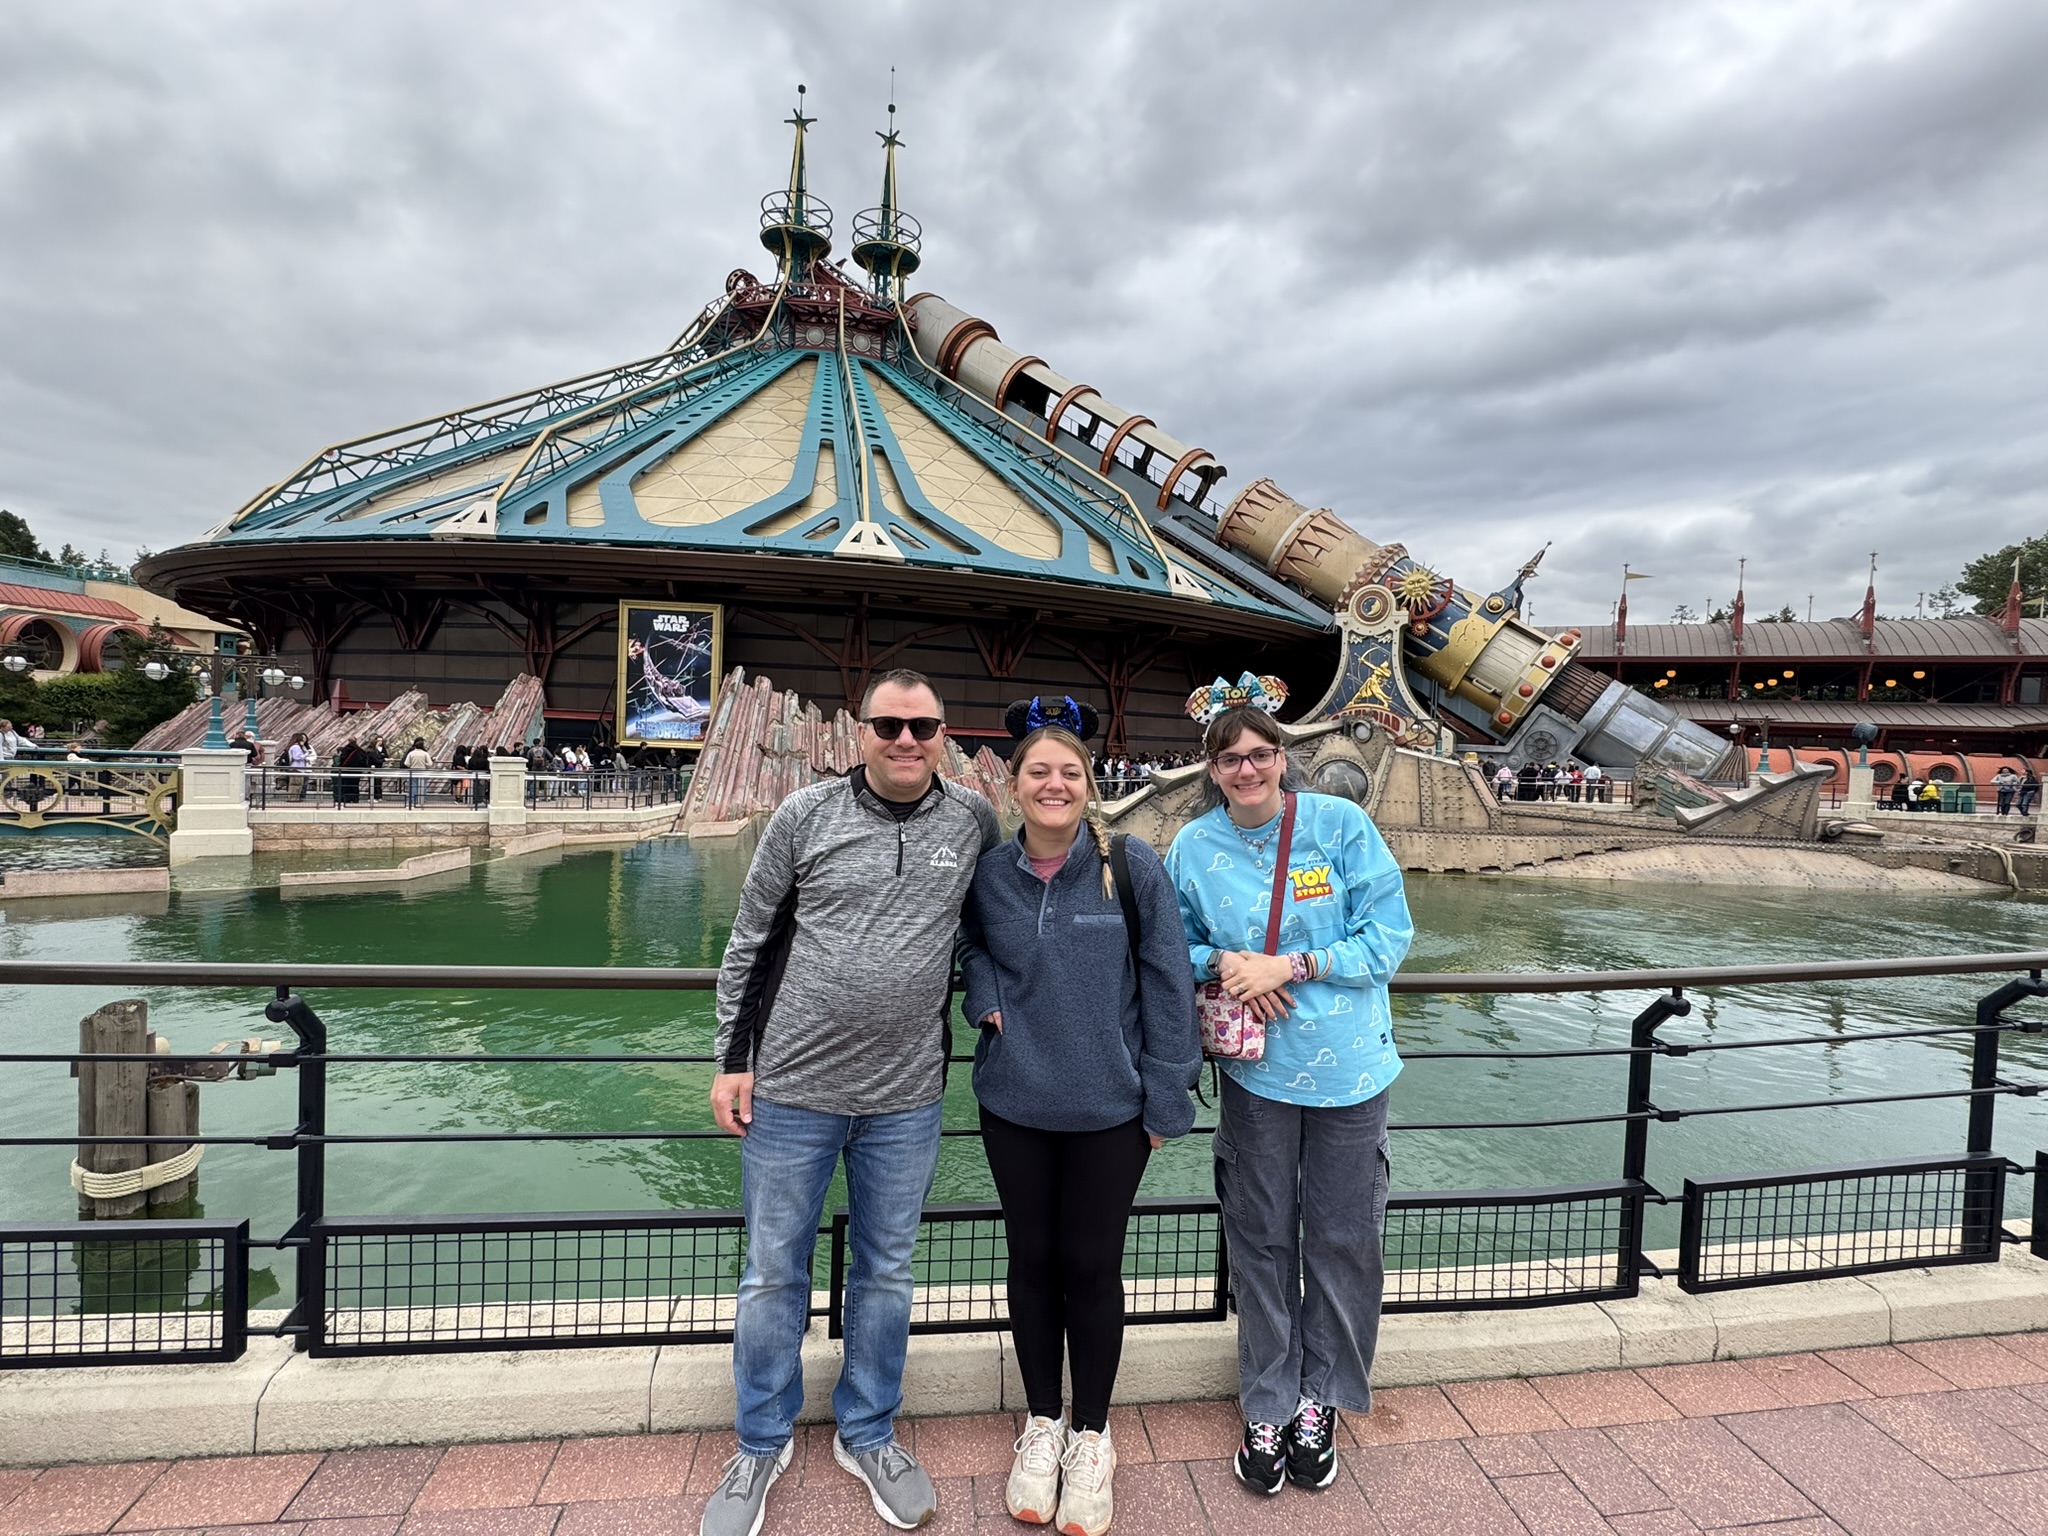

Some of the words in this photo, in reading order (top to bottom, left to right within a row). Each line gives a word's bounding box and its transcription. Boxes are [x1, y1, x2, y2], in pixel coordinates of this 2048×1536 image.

[653, 614, 689, 624] STAR
[653, 622, 689, 632] WARS
[1222, 687, 1250, 699] TOY
[1288, 865, 1331, 888] TOY
[1295, 886, 1330, 898] STORY
